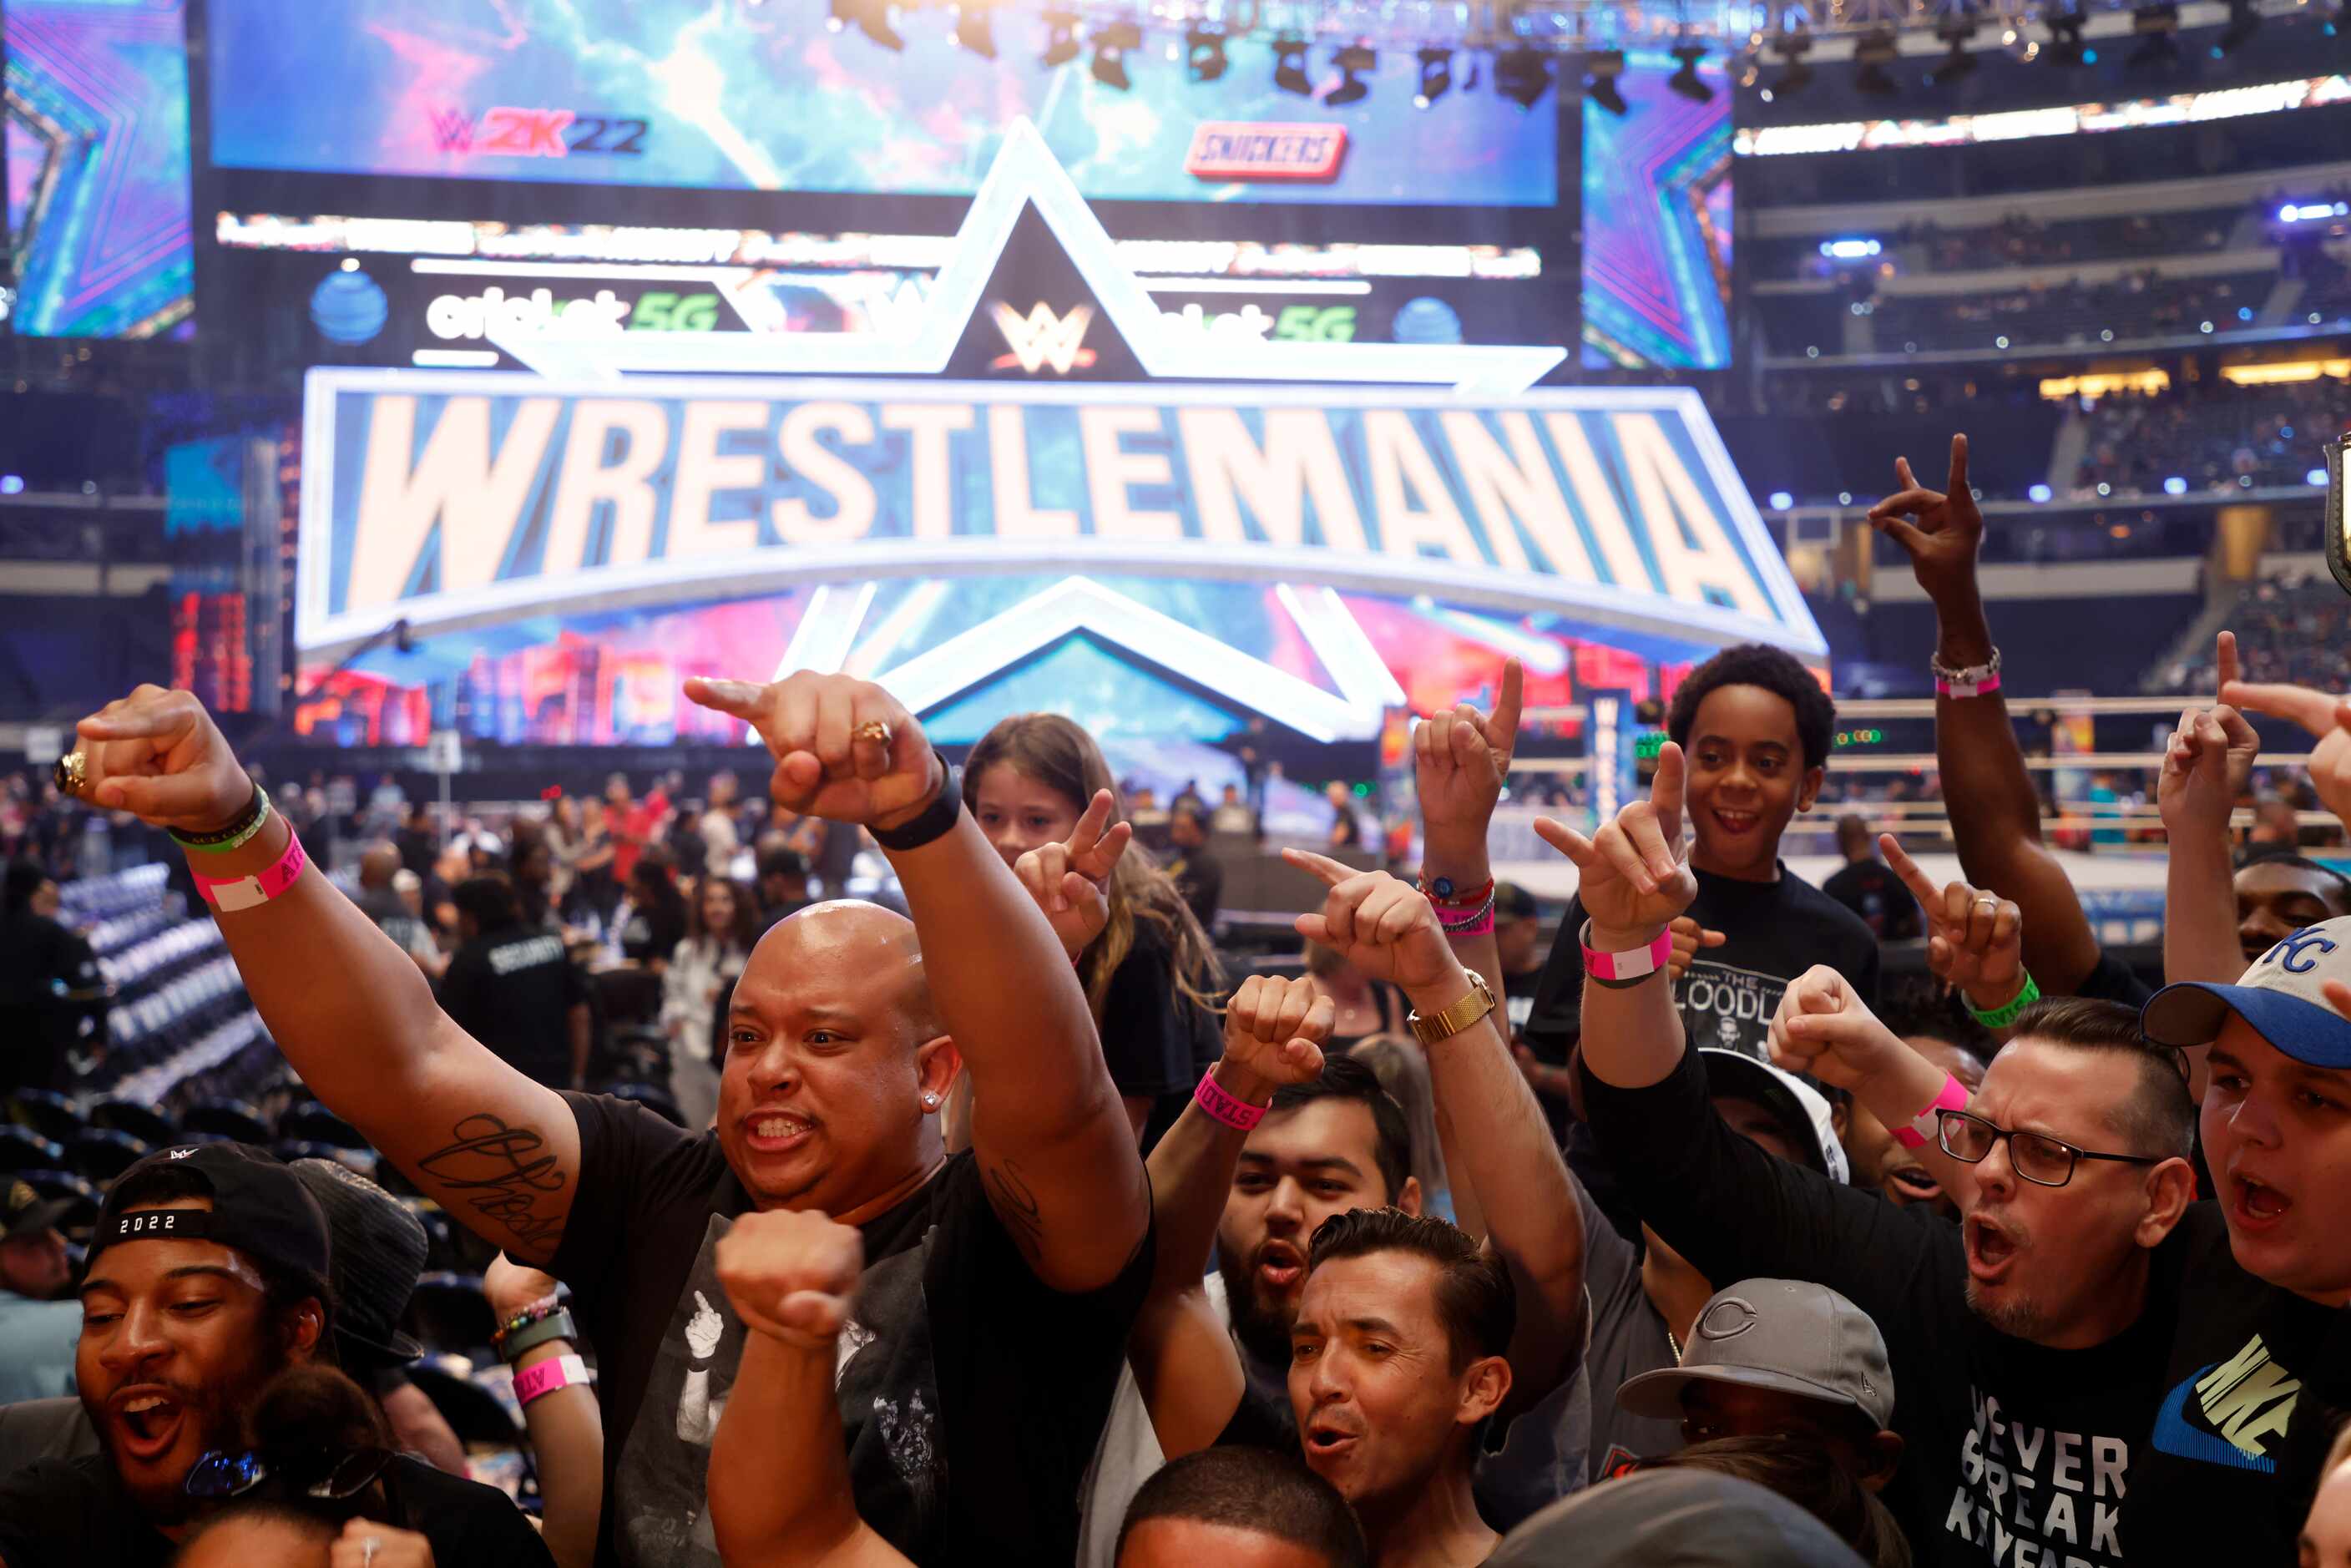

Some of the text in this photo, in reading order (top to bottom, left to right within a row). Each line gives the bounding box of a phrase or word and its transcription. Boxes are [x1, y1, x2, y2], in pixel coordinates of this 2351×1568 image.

[628, 292, 720, 332] 5G
[1273, 305, 1358, 343] 5G
[344, 394, 1773, 623] WRESTLEMANIA
[2261, 926, 2337, 974] KC
[1723, 970, 1759, 989] THE
[119, 1215, 174, 1234] 2022
[1697, 1297, 1757, 1341] C
[2195, 1333, 2303, 1460] NIKE
